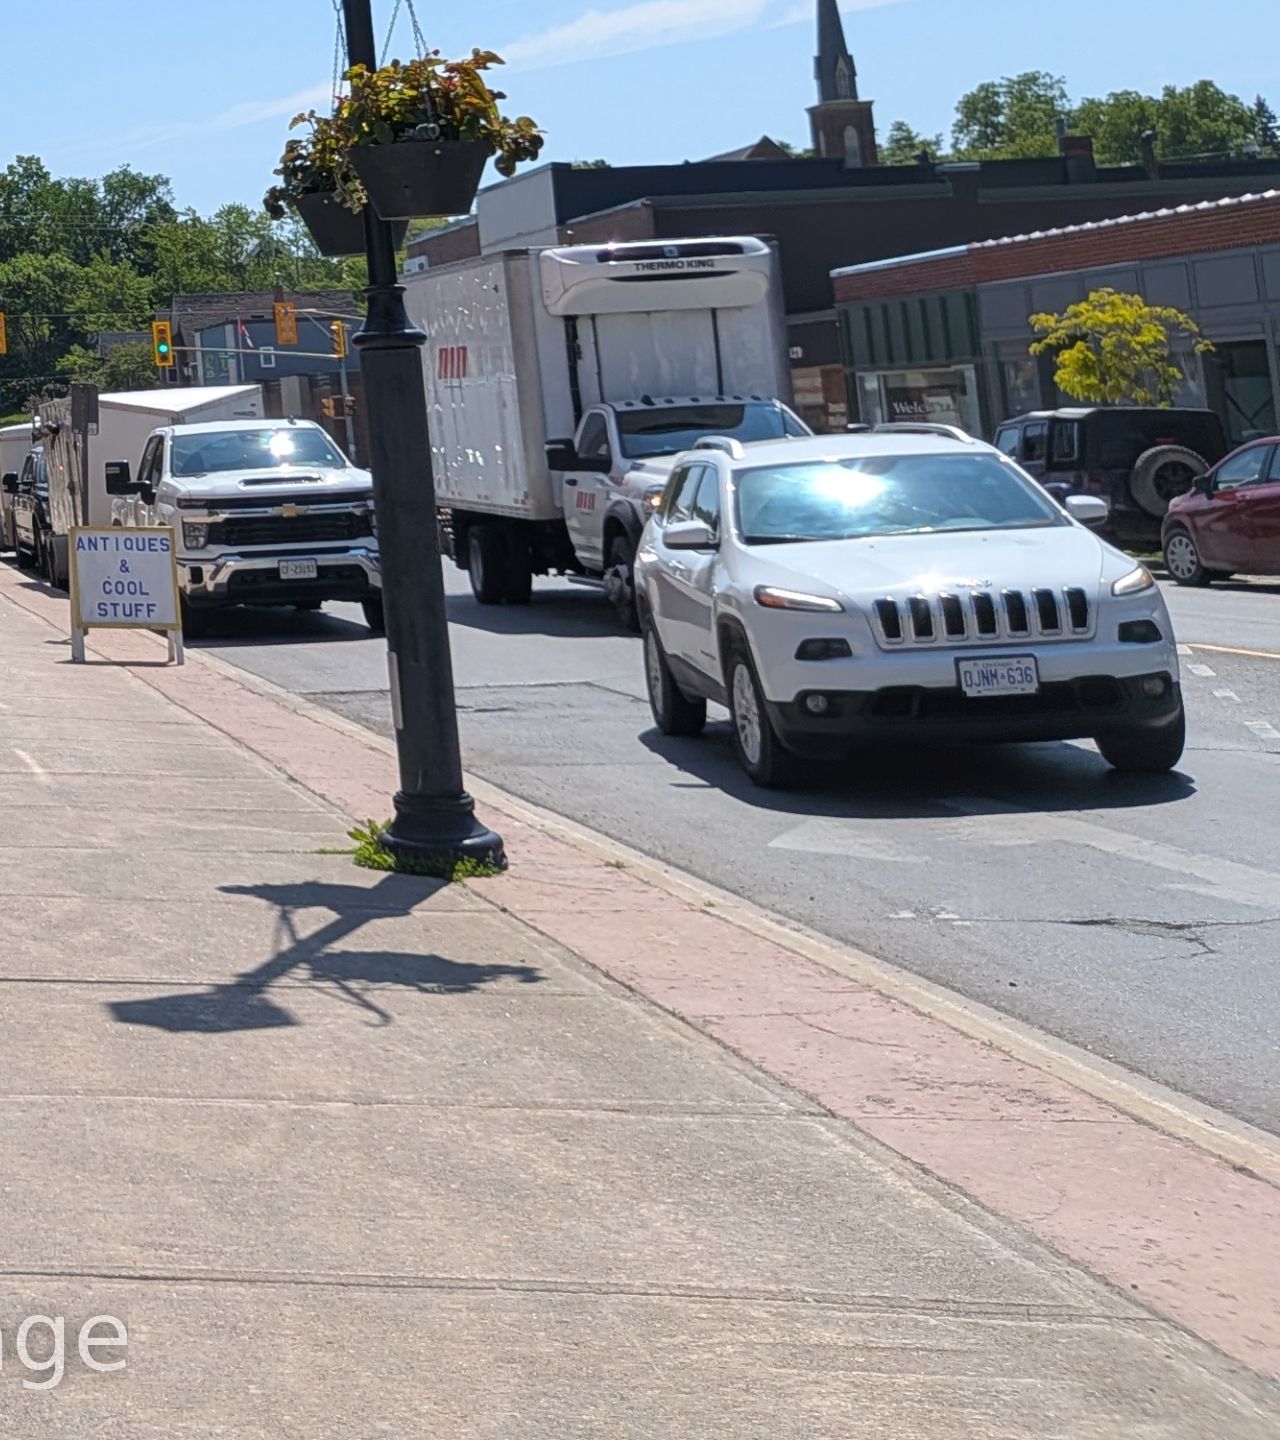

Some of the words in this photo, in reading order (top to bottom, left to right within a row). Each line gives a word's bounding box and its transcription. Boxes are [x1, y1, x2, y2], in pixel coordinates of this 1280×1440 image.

[634, 260, 685, 272] THERMO
[686, 259, 715, 268] KING
[76, 536, 170, 552] ANTIQUES
[119, 559, 130, 573] &
[102, 580, 150, 596] COOL
[97, 602, 156, 618] STUFF
